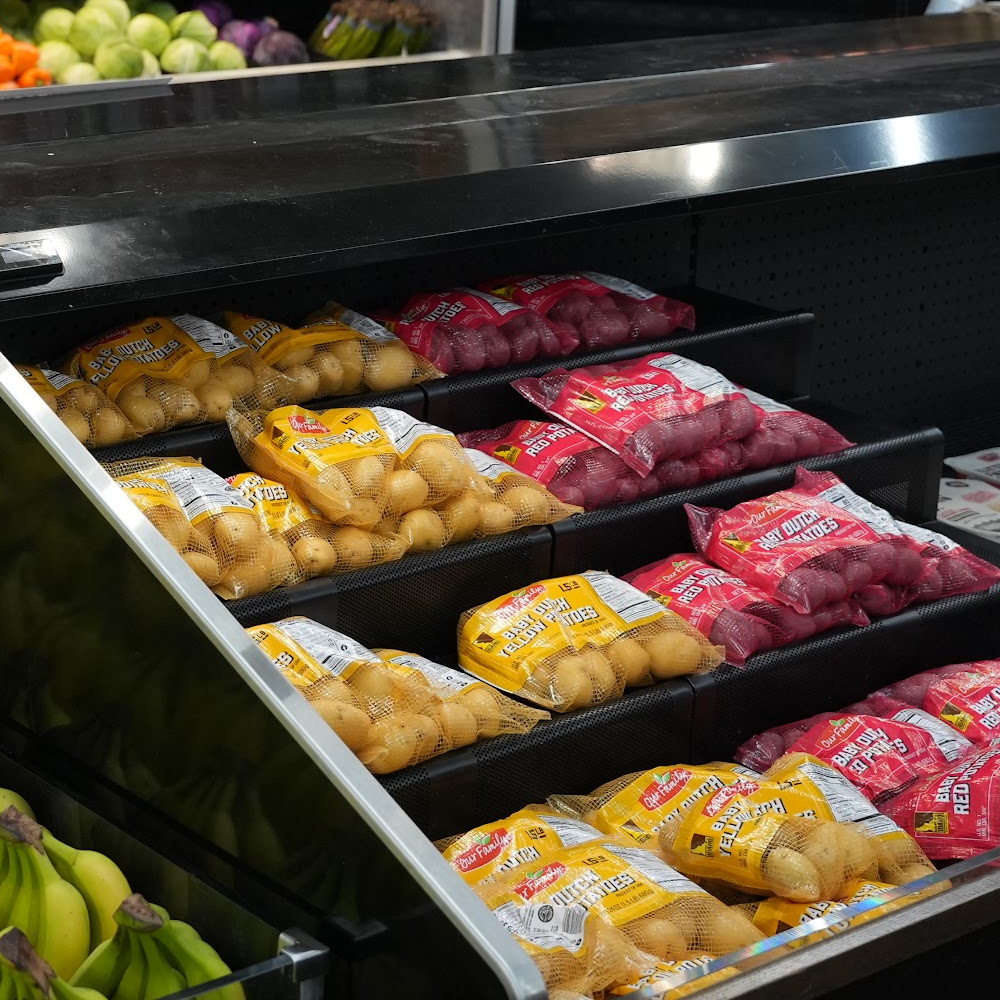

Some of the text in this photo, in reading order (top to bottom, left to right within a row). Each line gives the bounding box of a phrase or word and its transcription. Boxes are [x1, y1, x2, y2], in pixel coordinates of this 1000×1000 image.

[249, 325, 283, 352] LLOW
[524, 440, 553, 458] RED
[750, 508, 766, 524] Our
[781, 508, 822, 537] DUTCH
[669, 574, 700, 594] BABY
[676, 586, 704, 604] RED
[497, 618, 548, 658] YELLOW
[500, 613, 537, 640] BABY
[821, 714, 860, 748] Our Family
[831, 742, 862, 767] BABY
[643, 768, 692, 808] Our Family
[952, 783, 971, 815] RED
[459, 832, 513, 870] Our Family
[527, 864, 566, 891] Family
[549, 869, 601, 906] DUTCH
